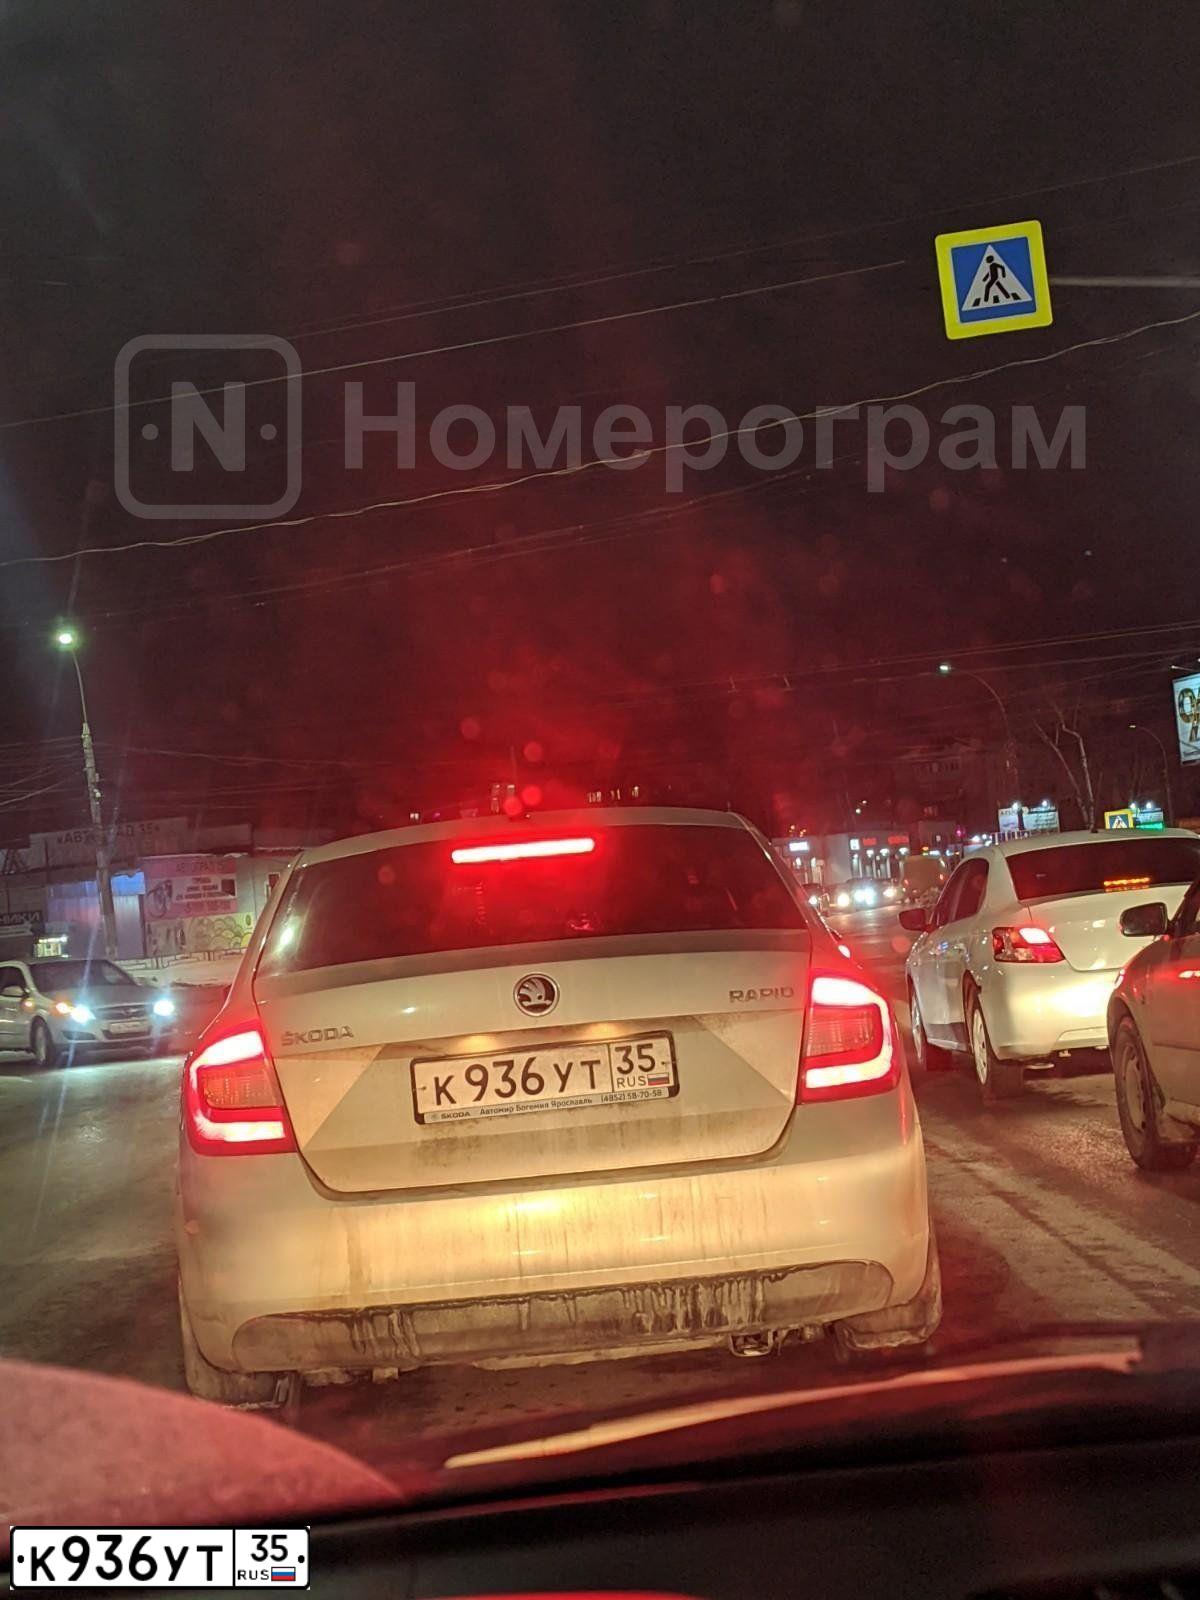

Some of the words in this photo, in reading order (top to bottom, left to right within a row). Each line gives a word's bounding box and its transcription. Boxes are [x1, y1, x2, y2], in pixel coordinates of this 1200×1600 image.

[729, 986, 794, 1003] RAPID
[614, 1043, 656, 1075] 35
[616, 1075, 647, 1089] RUS
[480, 1105, 514, 1116] Автомир
[515, 1102, 549, 1112] Богемия
[551, 1097, 593, 1110] Ярославль
[601, 1091, 626, 1103] (4852)
[627, 1089, 662, 1100] 58-70-58
